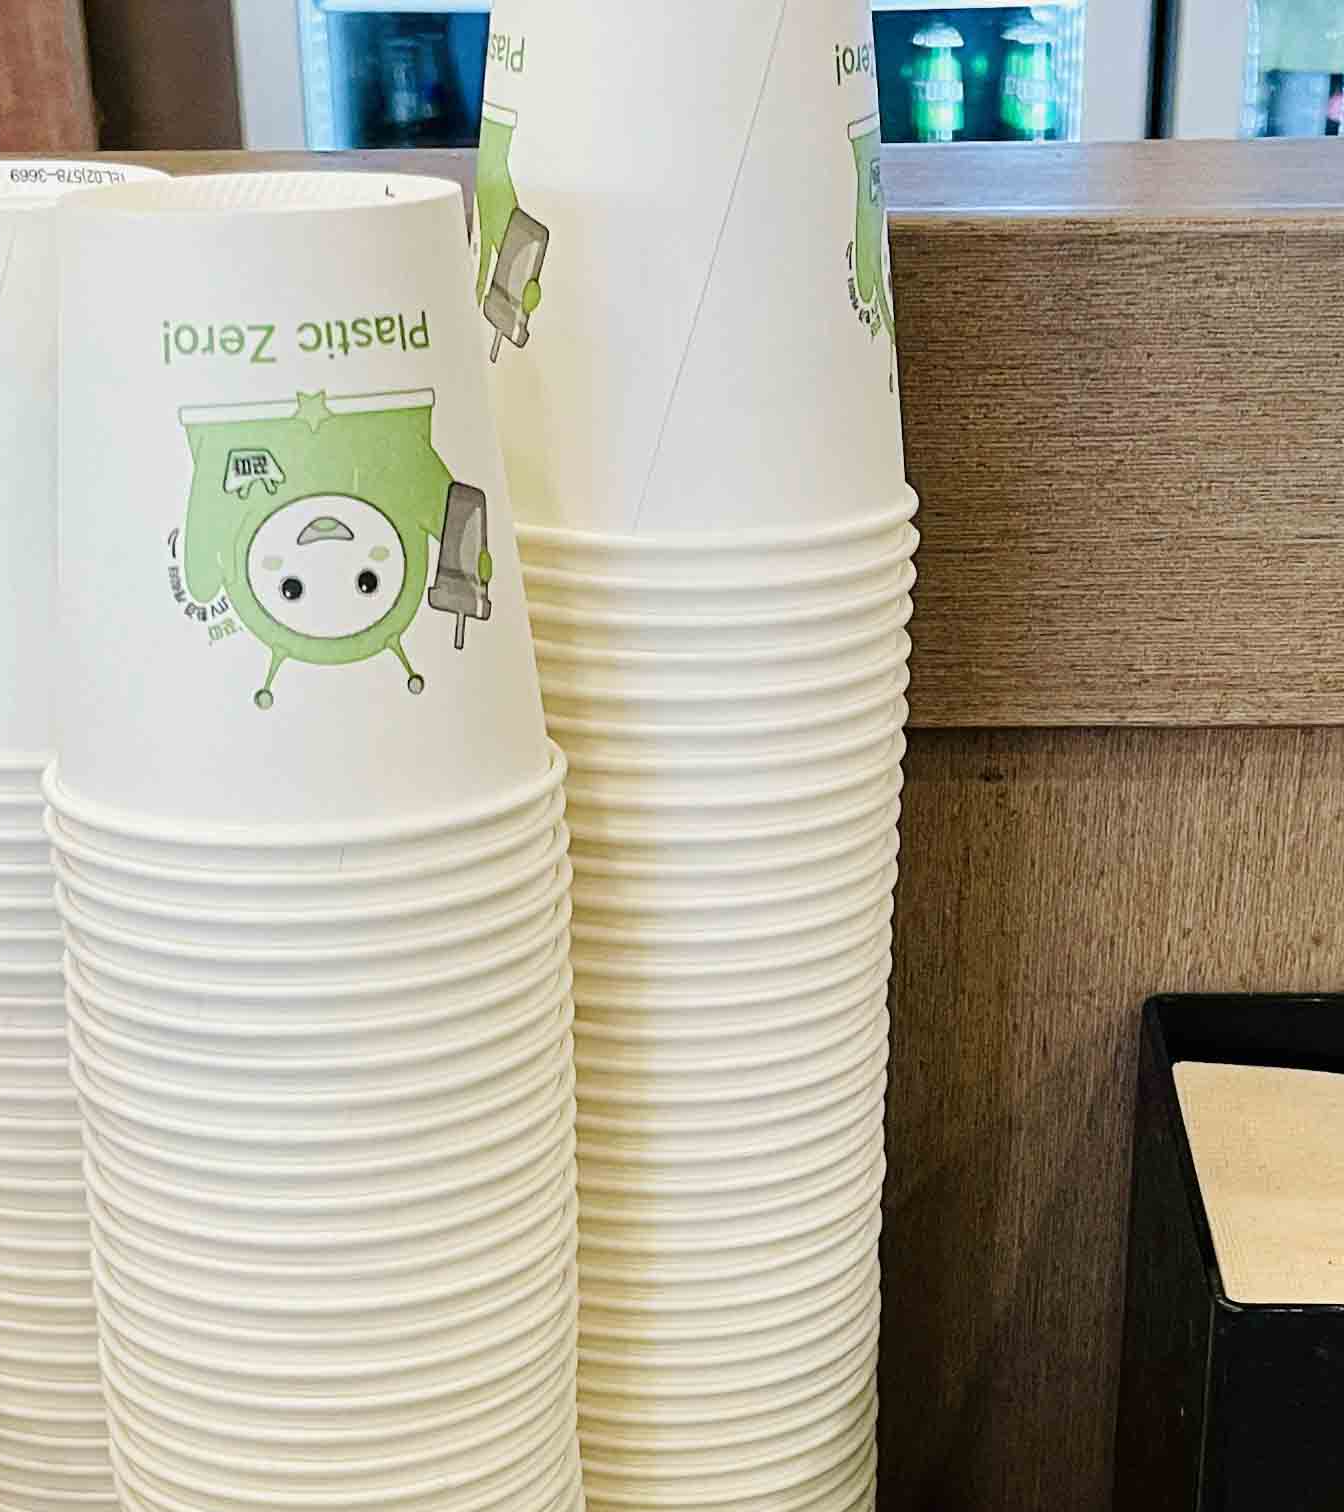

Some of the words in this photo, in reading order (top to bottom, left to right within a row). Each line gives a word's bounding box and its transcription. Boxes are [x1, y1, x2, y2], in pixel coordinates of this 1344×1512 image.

[834, 43, 875, 86] ero!
[162, 320, 277, 364] Zero!
[297, 311, 431, 360] Plastic
